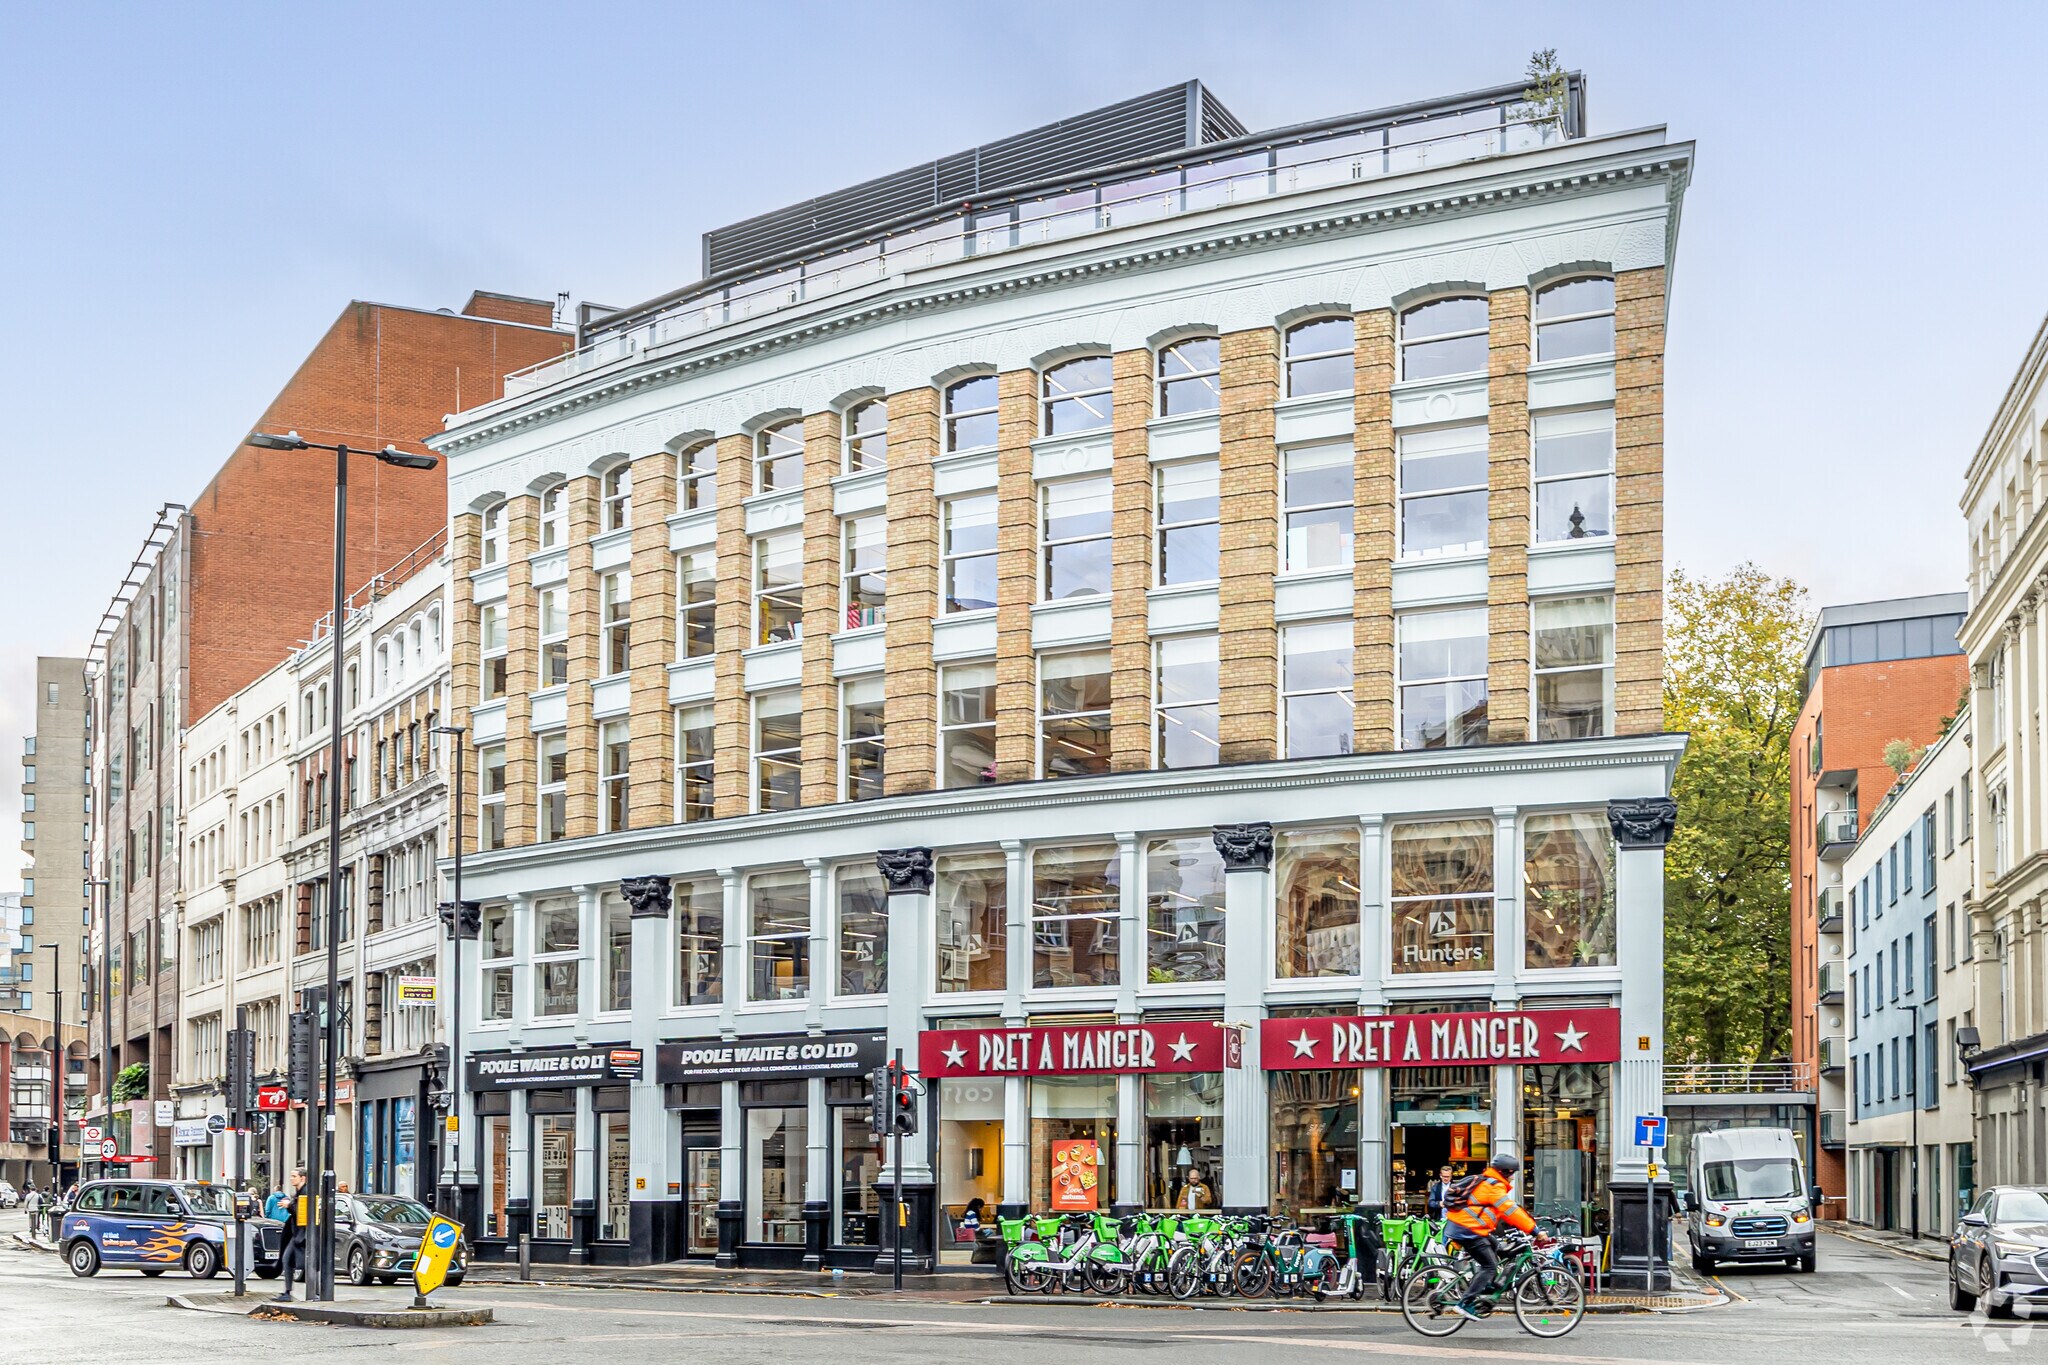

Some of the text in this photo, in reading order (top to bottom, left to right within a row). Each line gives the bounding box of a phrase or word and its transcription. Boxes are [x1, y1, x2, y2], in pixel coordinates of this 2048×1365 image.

[1403, 943, 1483, 963] Hunters
[1332, 1016, 1541, 1063] PRET A MANGER
[1639, 1037, 1650, 1050] H
[681, 1042, 858, 1065] POOLE WAITE & CO LTD
[978, 1028, 1156, 1072] PRET A MANGER
[479, 1059, 520, 1075] POOLE
[519, 1057, 560, 1073] WAITE
[559, 1056, 570, 1071] &
[570, 1055, 590, 1070] CO
[138, 1111, 148, 1124] 2
[103, 1143, 115, 1153] 20
[1649, 1165, 1658, 1177] H
